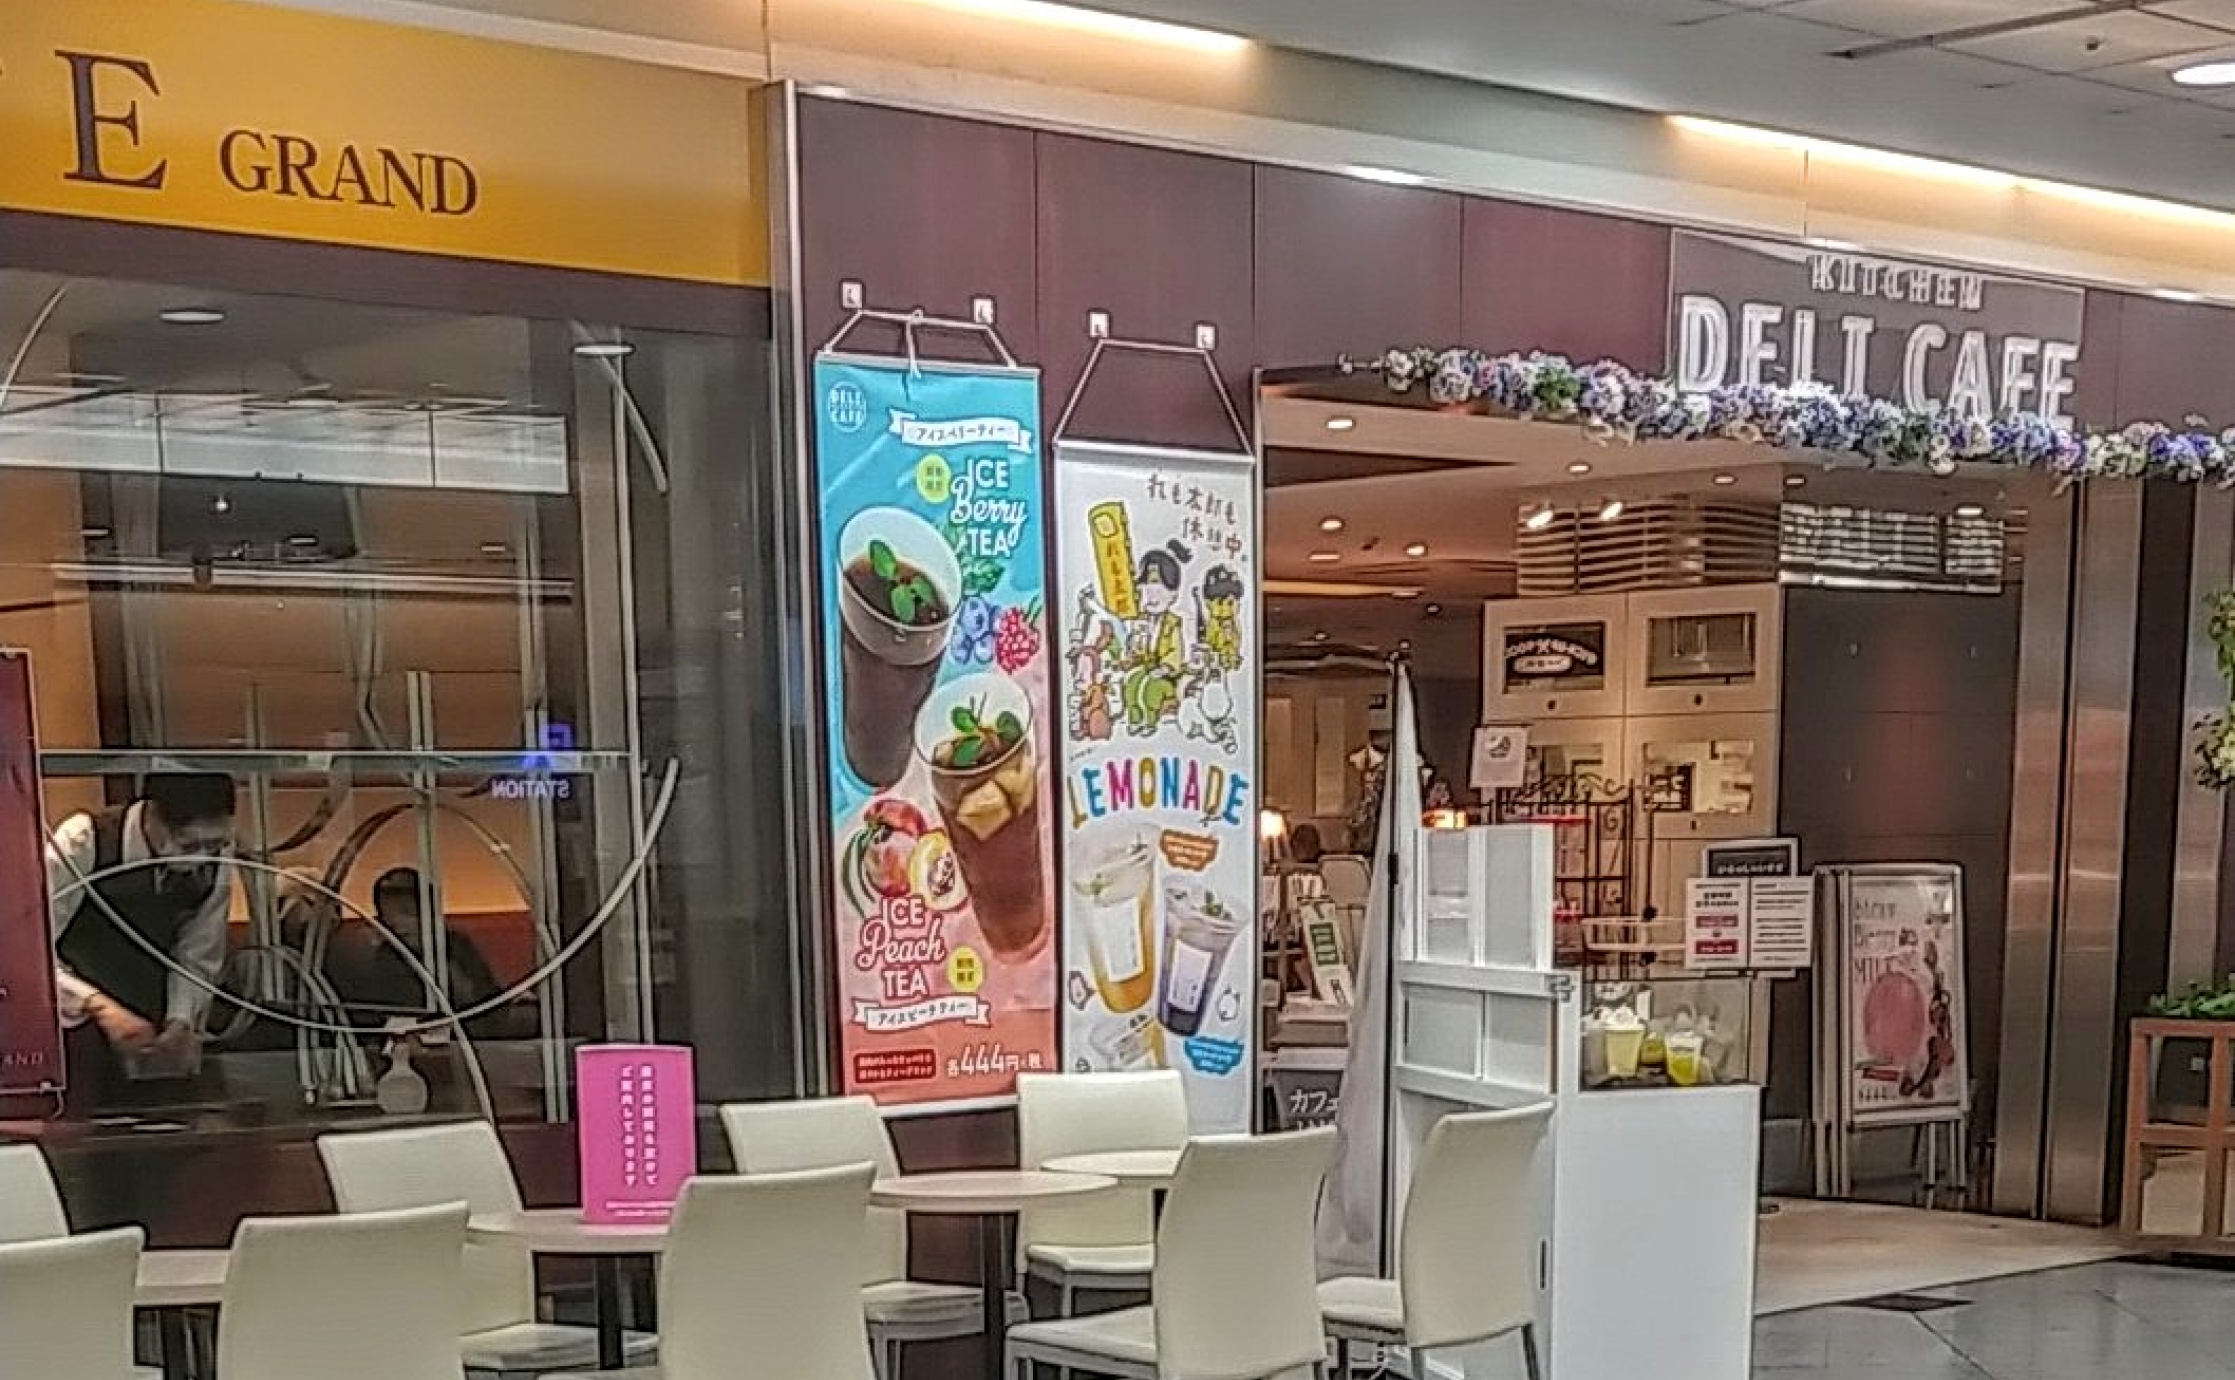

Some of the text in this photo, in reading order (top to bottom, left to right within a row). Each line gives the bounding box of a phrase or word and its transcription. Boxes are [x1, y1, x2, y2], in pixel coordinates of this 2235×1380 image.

[219, 128, 478, 216] GRAND
[1810, 254, 1984, 311] KITCHEN
[966, 458, 1009, 491] ICE
[950, 474, 1027, 547] Berry
[967, 528, 1011, 557] TEA
[1066, 757, 1250, 830] LEMONADE
[881, 898, 924, 926] ICE
[856, 915, 945, 968] Peach
[883, 969, 928, 998] TEA
